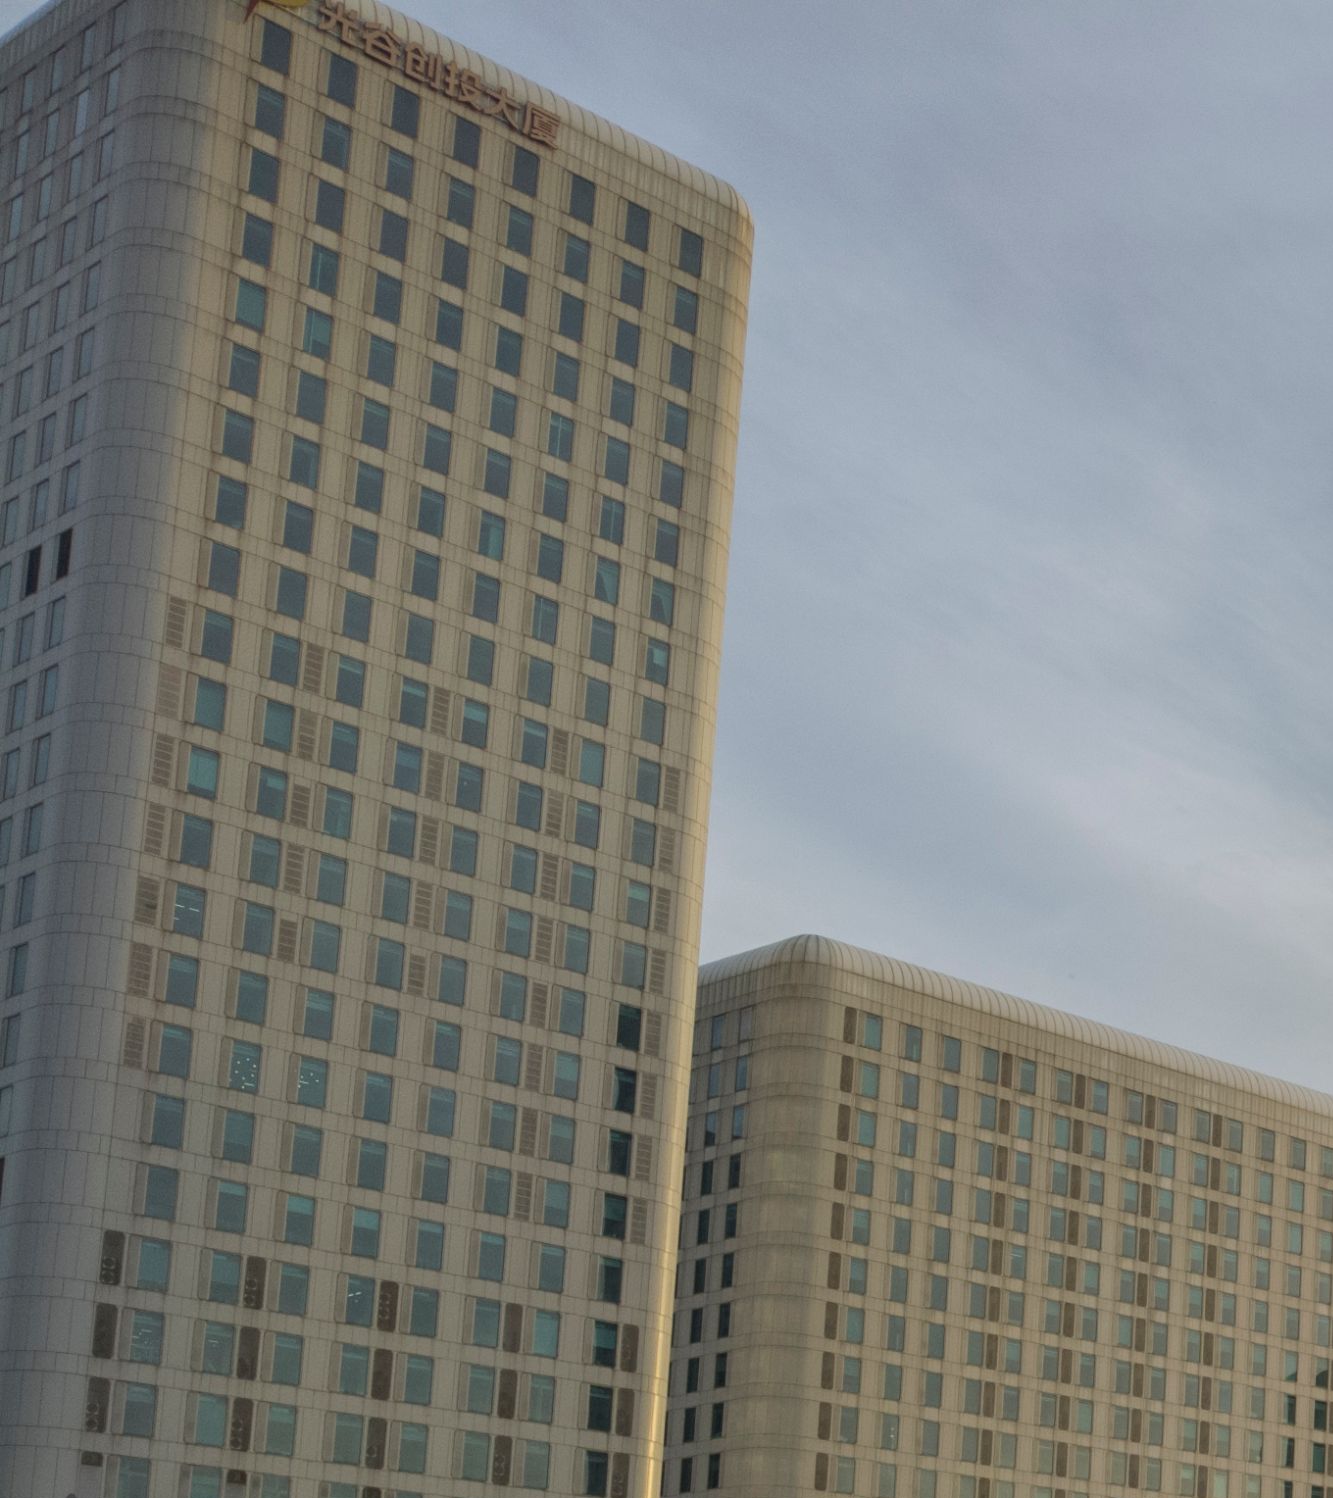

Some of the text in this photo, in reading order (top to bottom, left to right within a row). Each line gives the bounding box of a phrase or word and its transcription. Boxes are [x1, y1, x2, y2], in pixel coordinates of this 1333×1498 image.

[317, 3, 561, 150] 光谷创投大厦
